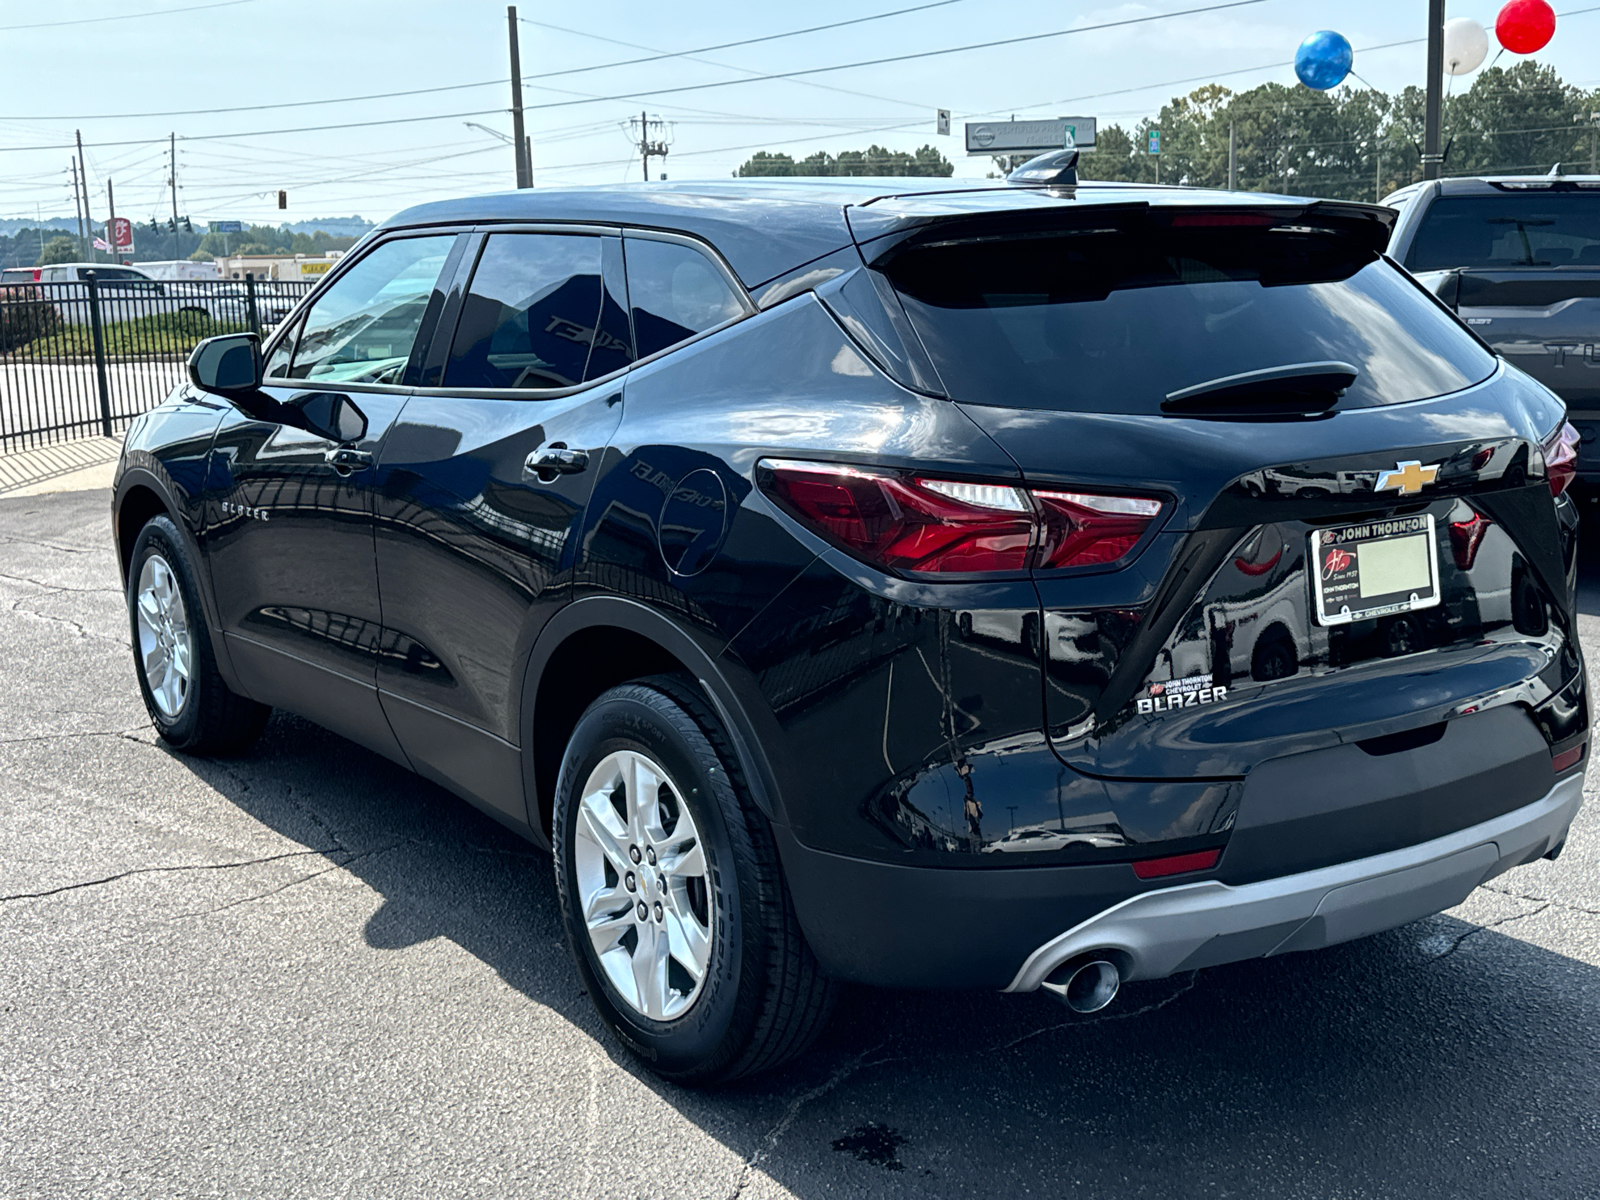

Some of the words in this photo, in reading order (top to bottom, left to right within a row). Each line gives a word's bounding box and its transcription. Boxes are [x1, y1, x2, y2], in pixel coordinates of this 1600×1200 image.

[222, 502, 269, 521] BLAZER
[1341, 526, 1370, 540] JOHN
[1372, 517, 1427, 536] THORNTON
[1365, 606, 1399, 617] CHEVROLET
[1165, 679, 1181, 689] JOHN
[1181, 674, 1213, 686] THORNTON
[1165, 684, 1202, 695] CHEVROLET
[1137, 686, 1228, 715] BLAZER
